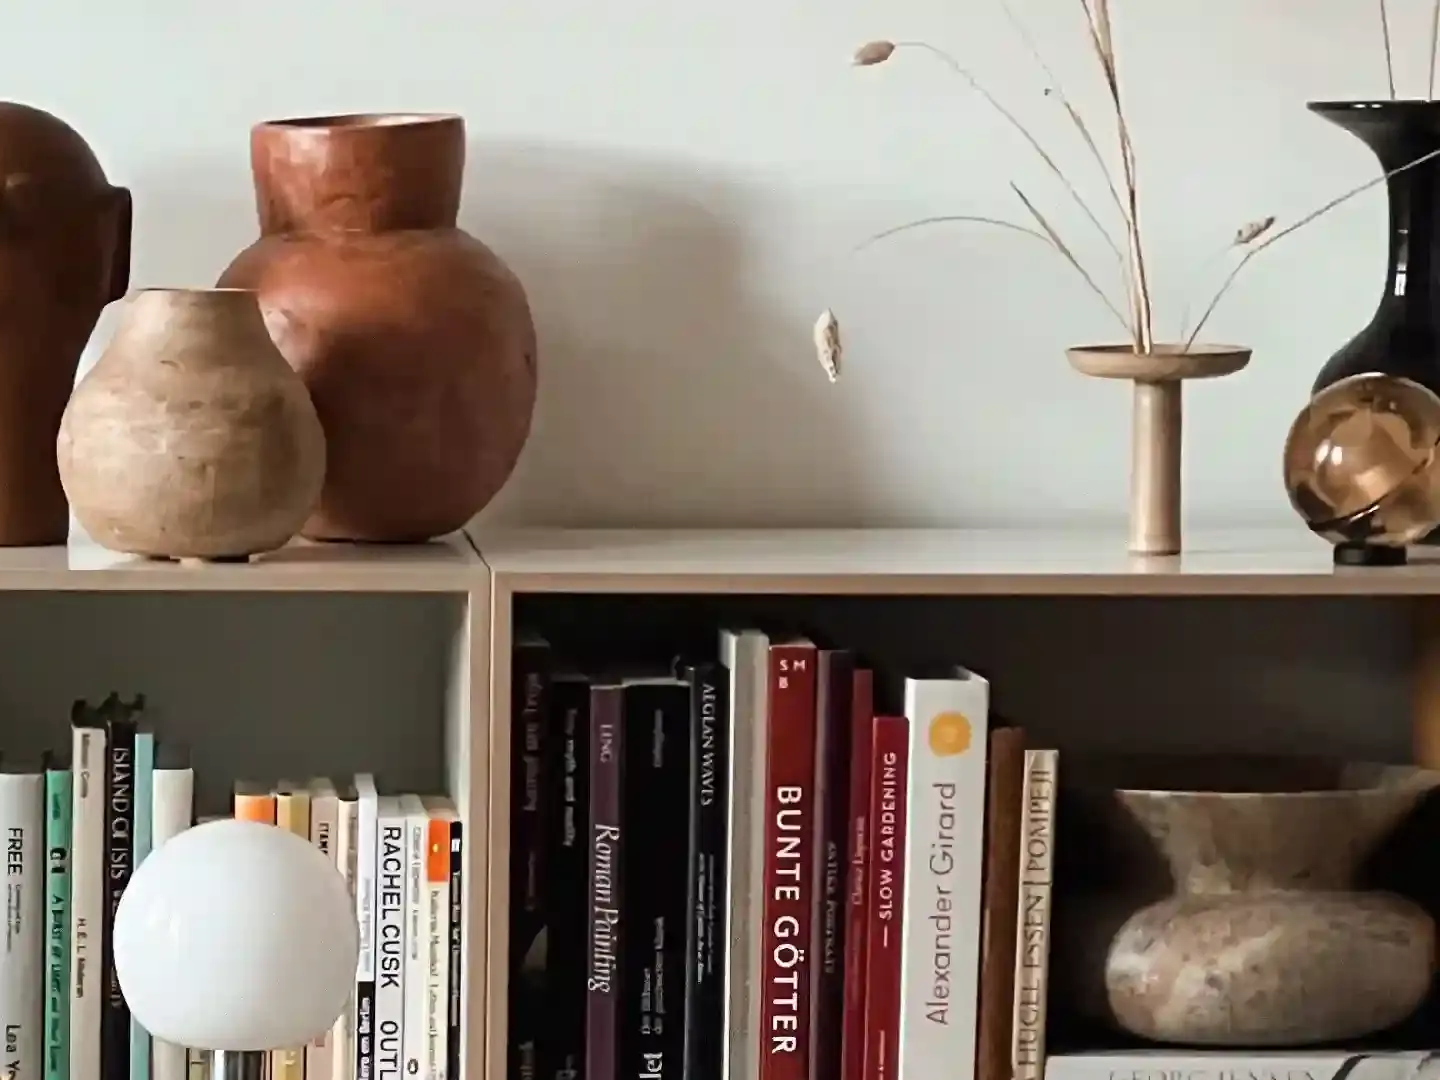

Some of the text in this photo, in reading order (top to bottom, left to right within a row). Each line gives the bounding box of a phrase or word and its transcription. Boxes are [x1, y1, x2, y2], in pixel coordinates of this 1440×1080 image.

[110, 748, 130, 812] ISLAND
[6, 827, 25, 876] FREE
[109, 847, 129, 881] ISIS
[381, 827, 402, 920] RACHEL
[878, 752, 897, 921] SLOW GARDENING
[588, 824, 621, 993] Roman Painting
[771, 786, 805, 1054] BUNTE GÖTTER
[924, 782, 957, 1026] Alexander Girard
[1022, 893, 1045, 969] ESSEN
[379, 924, 401, 988] CUSK
[5, 1024, 22, 1053] Lea
